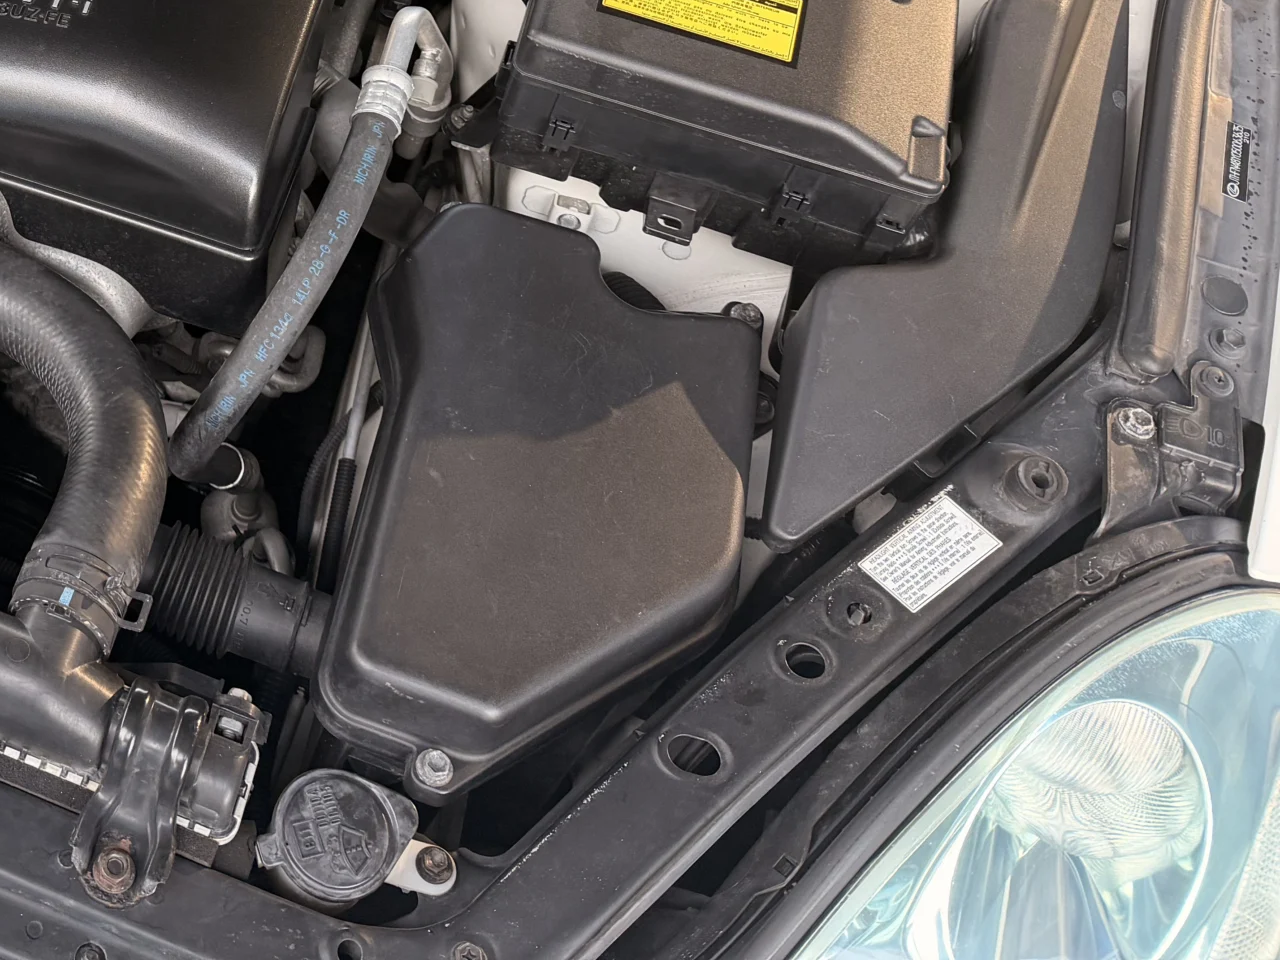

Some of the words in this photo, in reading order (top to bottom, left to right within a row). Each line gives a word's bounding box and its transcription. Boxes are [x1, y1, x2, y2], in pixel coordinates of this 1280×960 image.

[253, 337, 275, 363] HFC
[353, 143, 378, 185] NICHIRIN
[868, 547, 890, 564] HEADLIGHT
[888, 533, 908, 548] VERTICAL
[906, 522, 921, 534] AIMING
[919, 504, 943, 524] ADJUSTMENT
[888, 547, 901, 558] Vertical
[905, 534, 918, 544] Screws
[925, 520, 935, 528] same
[898, 557, 911, 567] Manual
[914, 545, 927, 555] Aiming
[924, 533, 942, 547] Adjustment
[875, 566, 889, 577] Turning
[886, 560, 897, 568] Ratio
[891, 568, 911, 584] RÉGLAGE
[908, 554, 928, 570] VERTICAL
[926, 548, 936, 556] DES
[934, 536, 951, 550] PHARES
[892, 582, 905, 592] Tourner
[908, 571, 918, 579] deux
[937, 547, 949, 557] vertical
[903, 594, 913, 602] Pour
[916, 578, 934, 592] instructions
[958, 549, 971, 559] manuel
